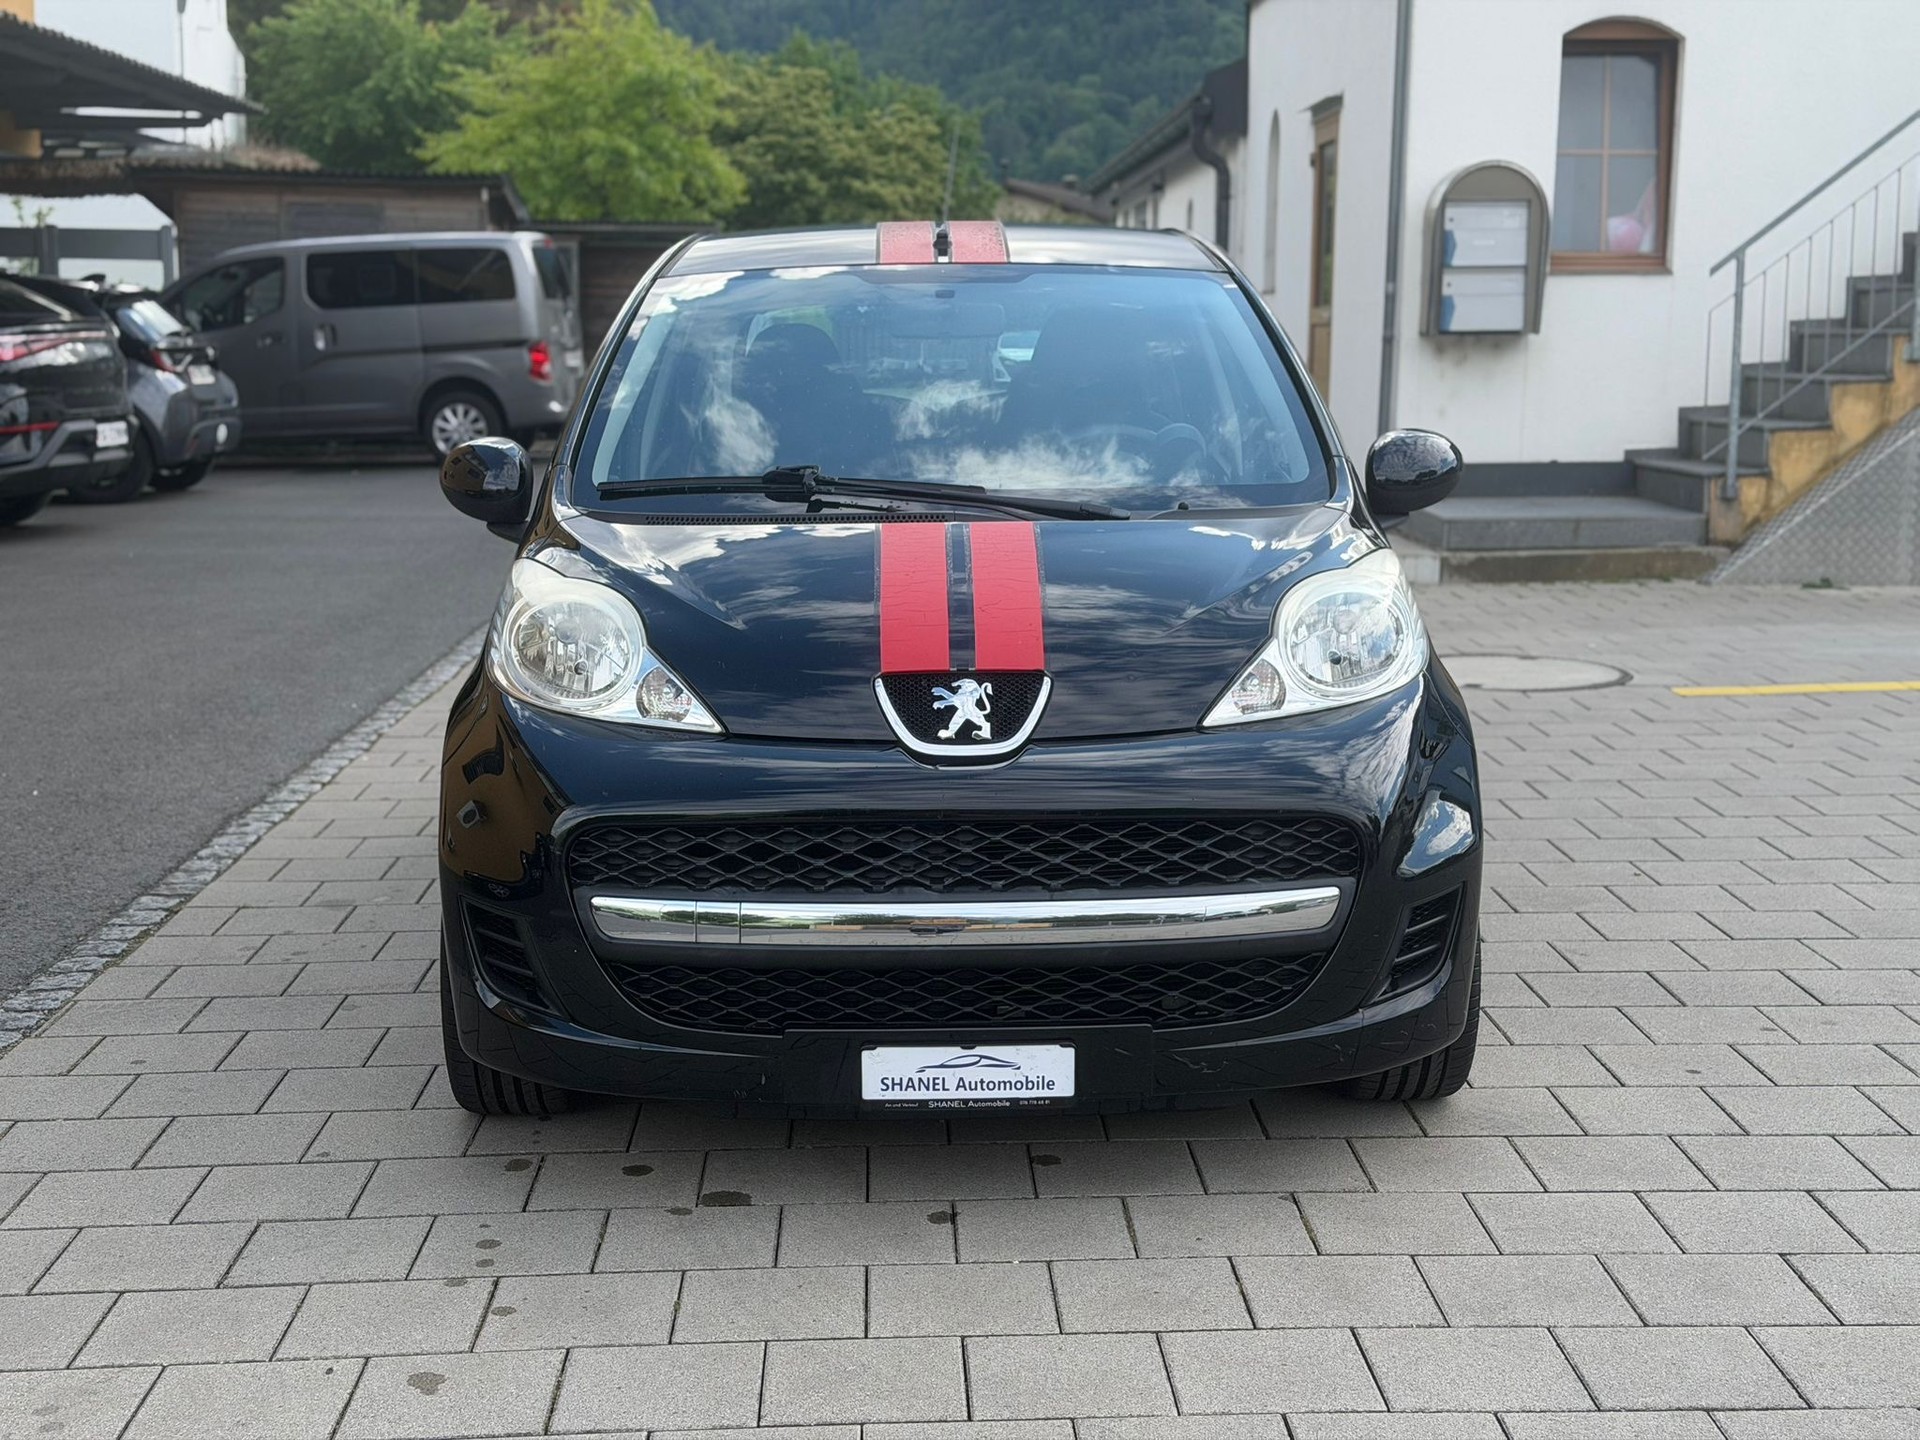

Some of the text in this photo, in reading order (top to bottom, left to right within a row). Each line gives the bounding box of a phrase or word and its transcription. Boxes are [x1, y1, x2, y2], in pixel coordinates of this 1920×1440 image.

[880, 1075, 1056, 1092] SHANEL Automobile
[928, 1100, 966, 1108] SHANEL
[967, 1099, 1011, 1108] Automobile
